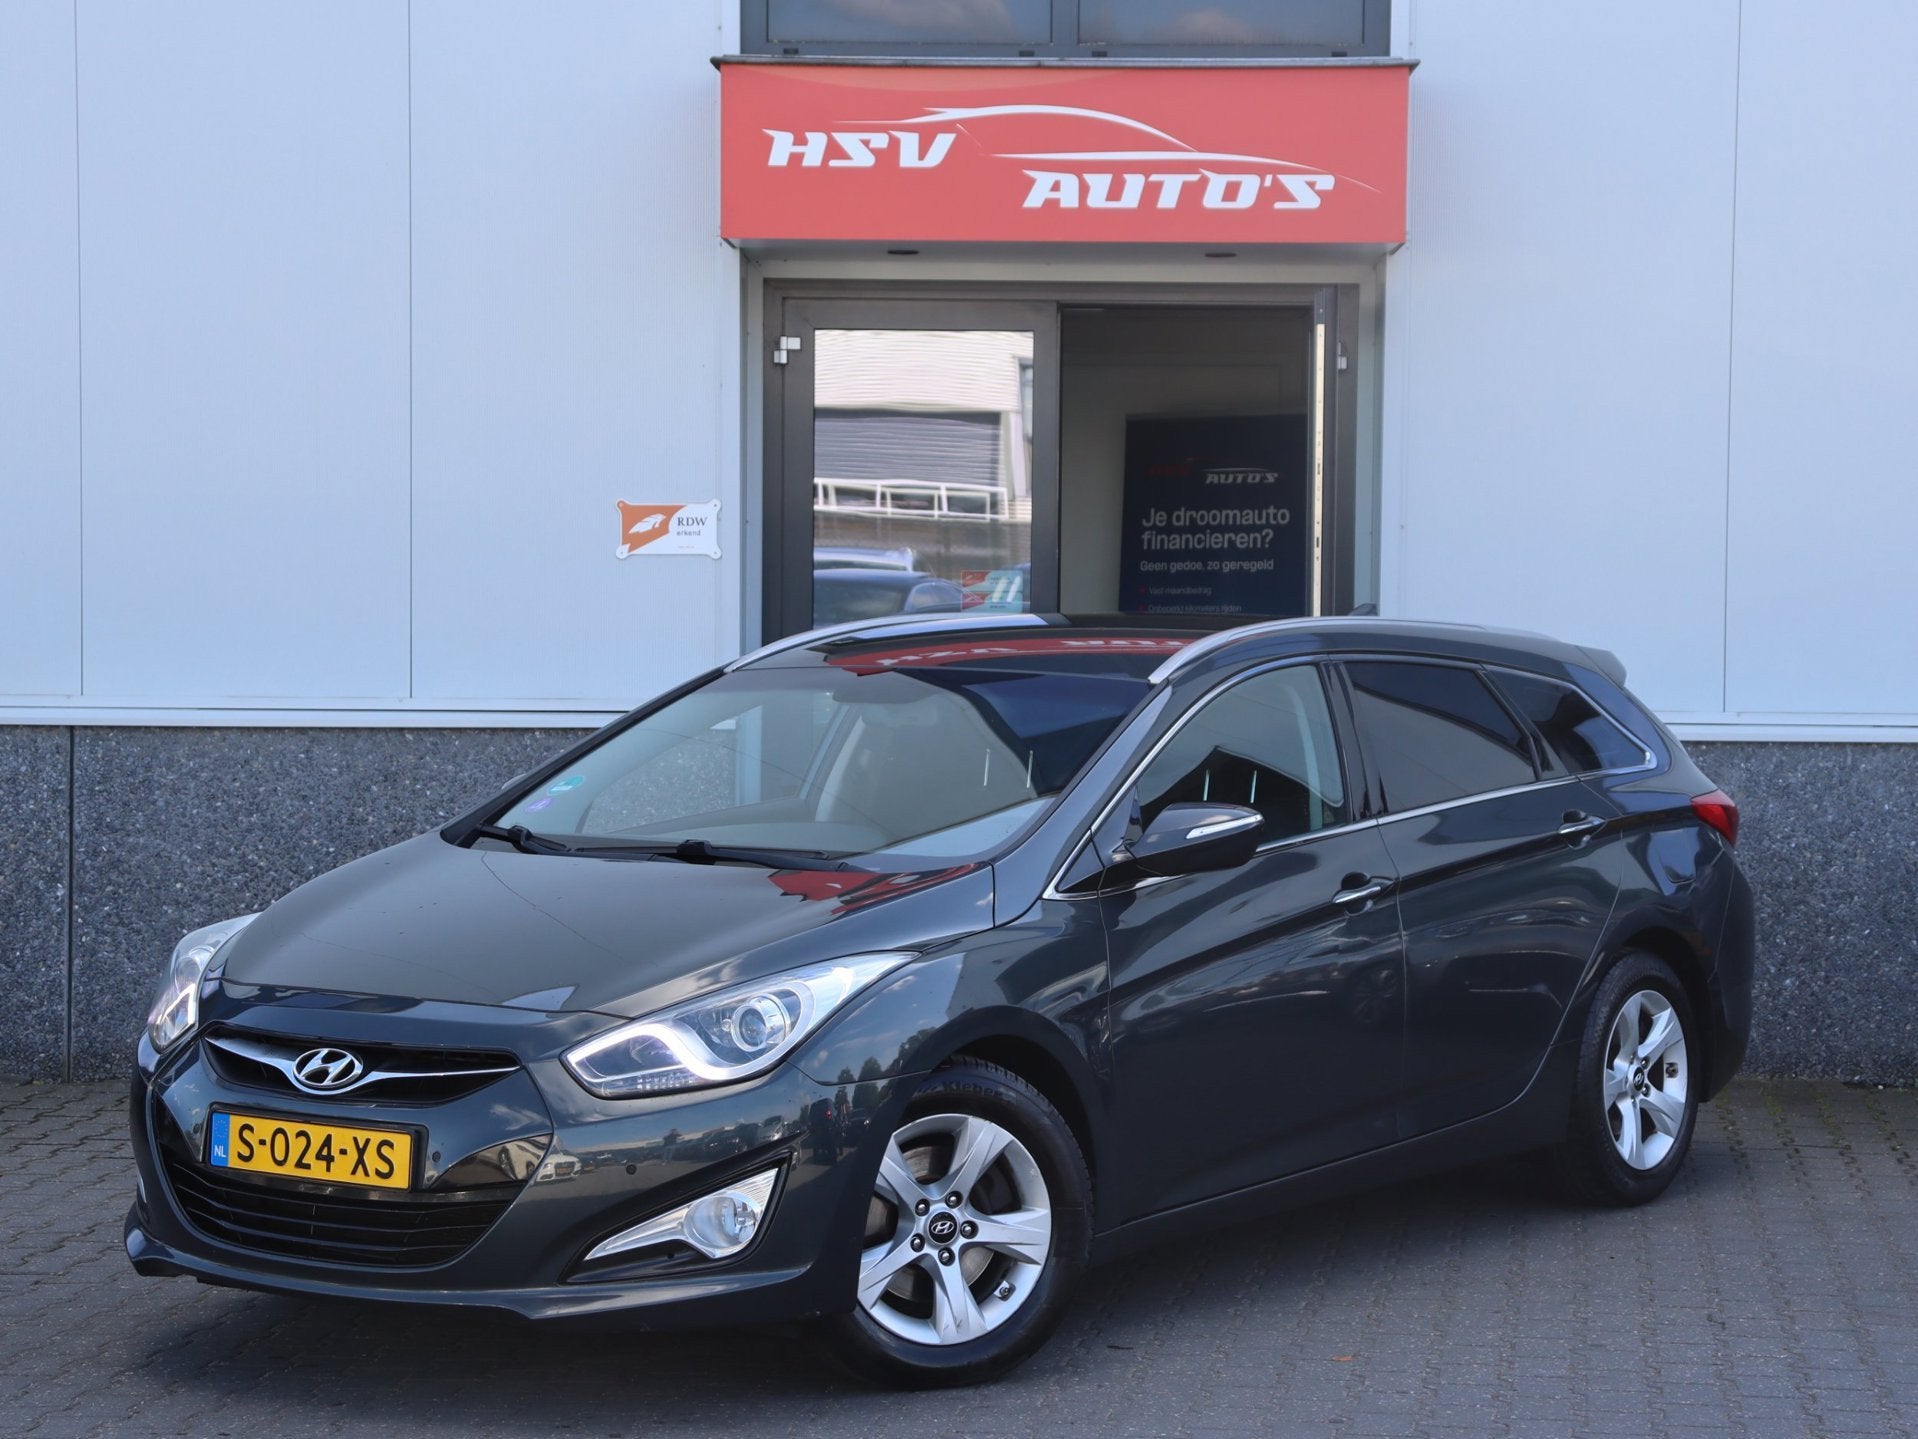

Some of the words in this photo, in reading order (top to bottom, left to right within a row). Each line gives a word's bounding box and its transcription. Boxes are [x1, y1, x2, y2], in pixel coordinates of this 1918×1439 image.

[762, 129, 956, 168] HSV
[1021, 168, 1335, 210] AUTO'S
[1206, 472, 1279, 484] AUTO'S
[677, 517, 707, 526] RDW
[1142, 508, 1167, 527] Je
[1172, 505, 1290, 526] droomauto
[1142, 529, 1274, 550] financieren?
[1140, 561, 1167, 571] Geen
[1207, 561, 1220, 570] zo
[1222, 559, 1274, 573] geregeld
[214, 1146, 227, 1158] NL
[237, 1124, 395, 1180] S-024-XS
